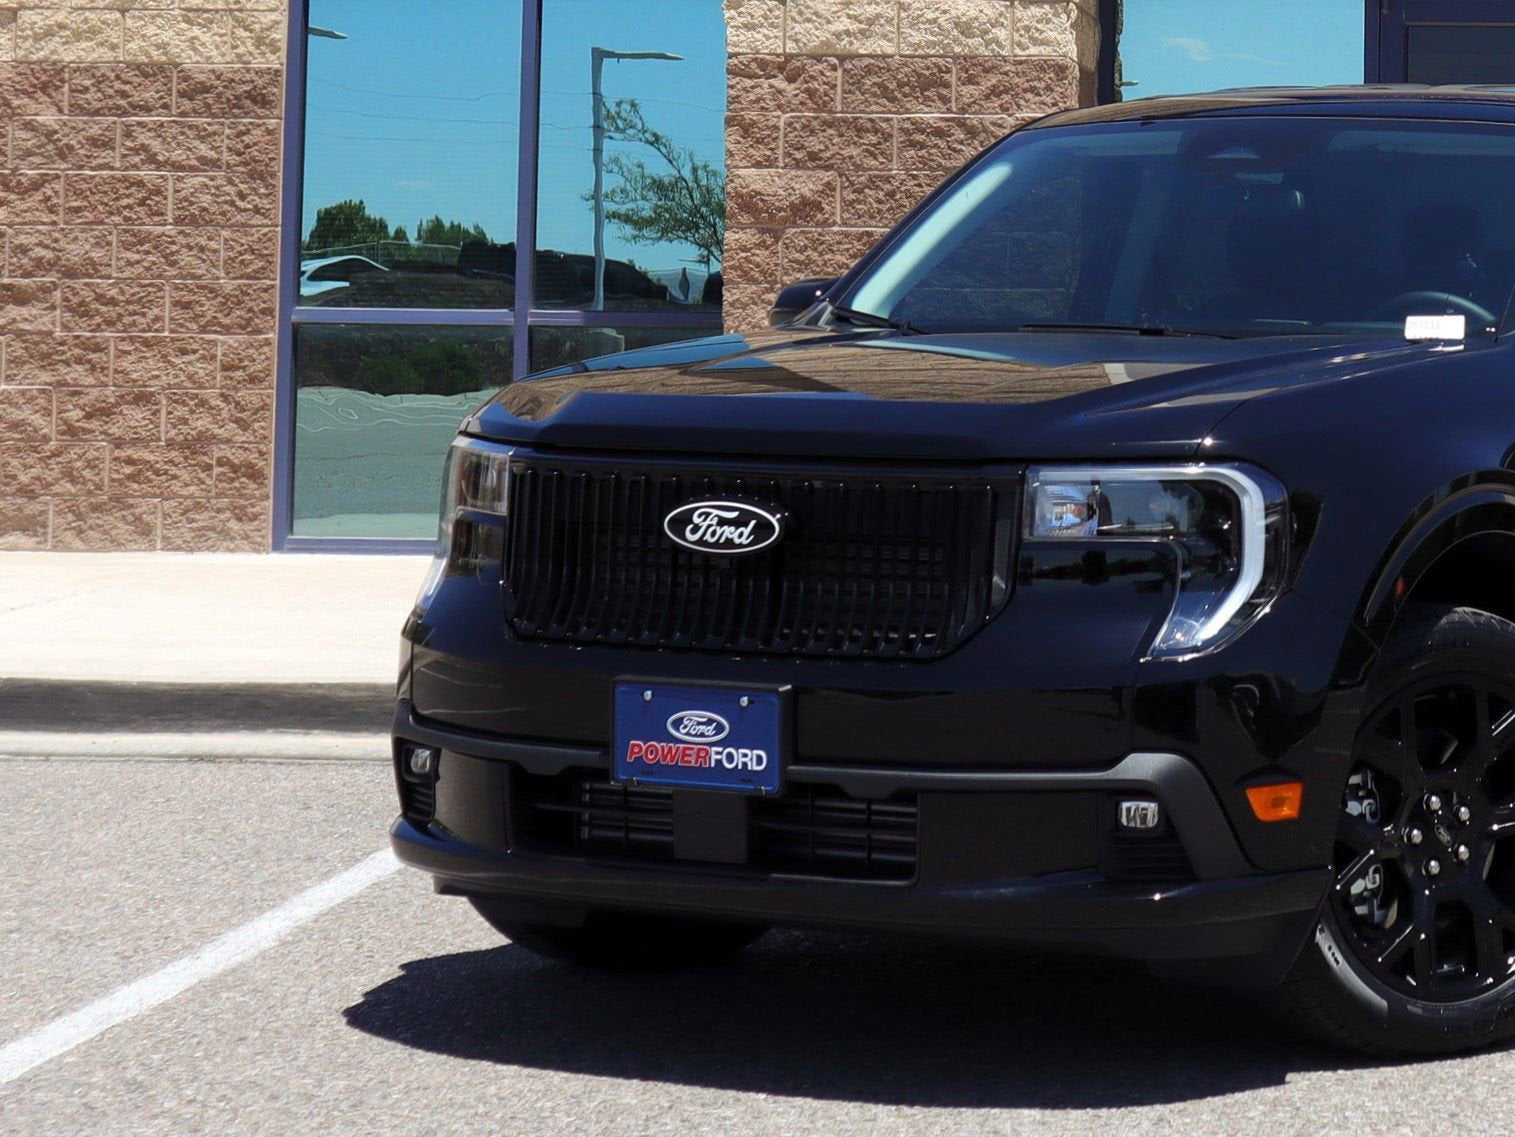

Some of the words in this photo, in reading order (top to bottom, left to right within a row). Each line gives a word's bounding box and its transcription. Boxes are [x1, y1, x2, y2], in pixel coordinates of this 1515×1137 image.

[685, 508, 757, 545] Ford
[679, 715, 718, 737] Ford
[627, 740, 768, 771] POWERFORD
